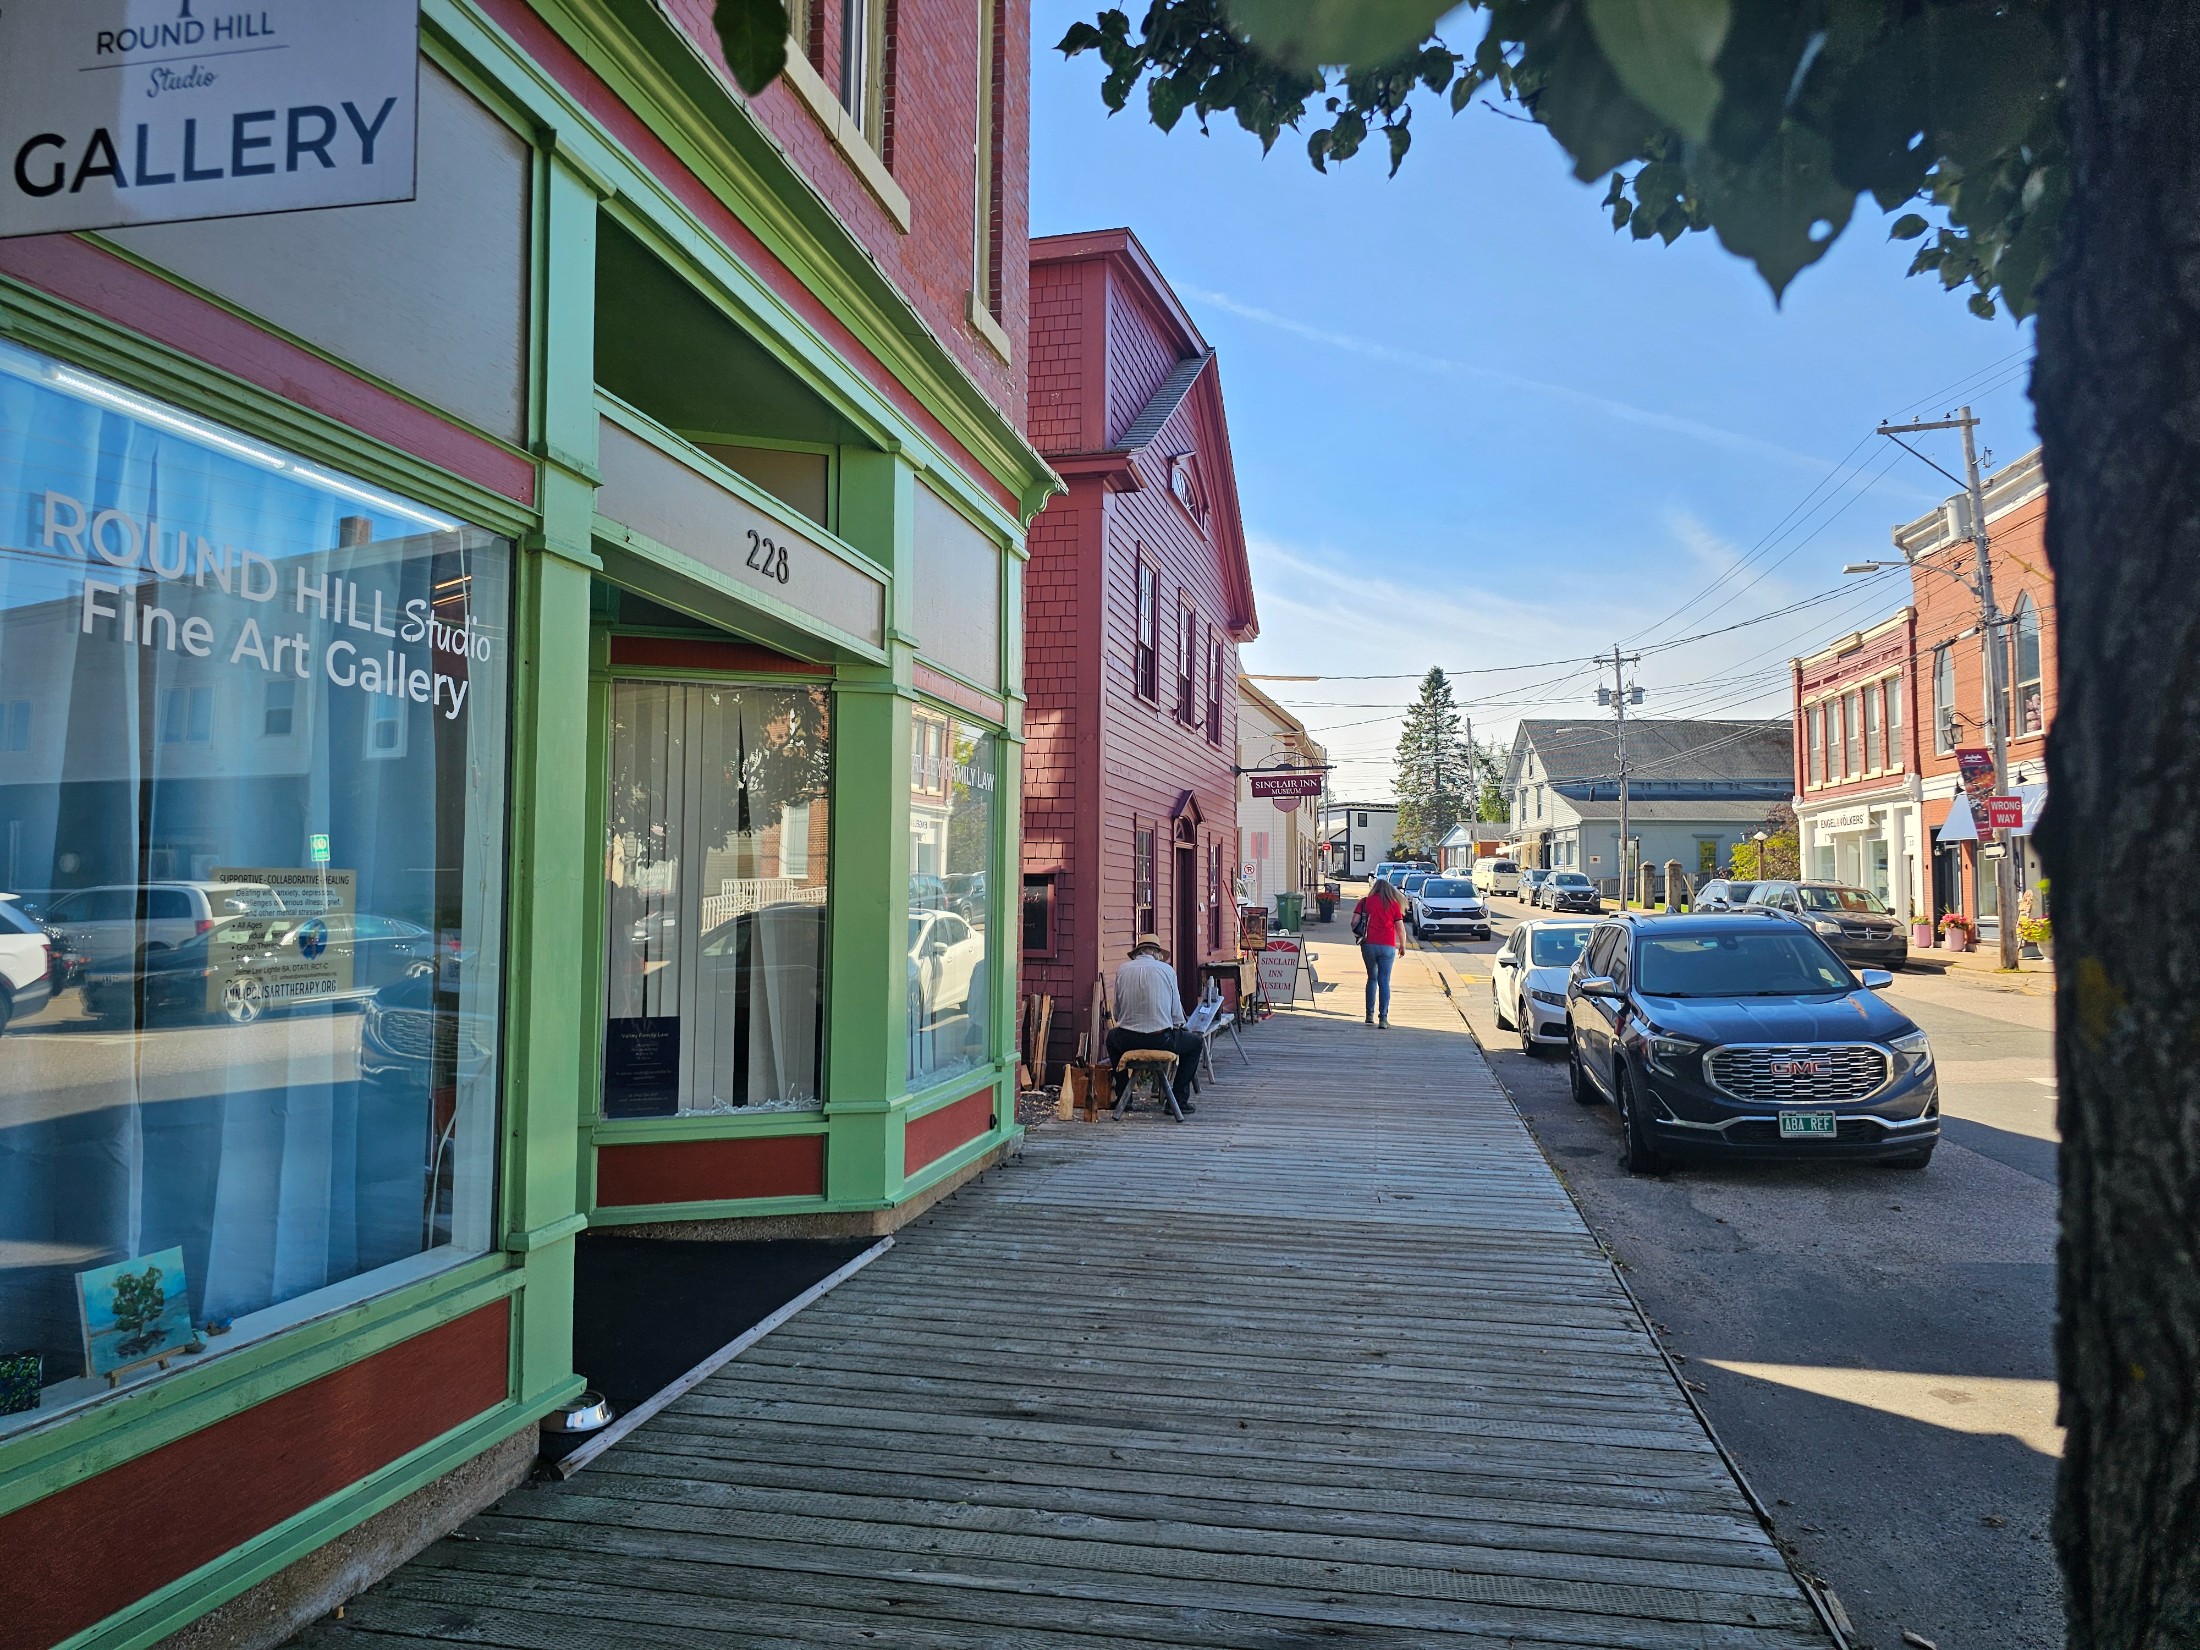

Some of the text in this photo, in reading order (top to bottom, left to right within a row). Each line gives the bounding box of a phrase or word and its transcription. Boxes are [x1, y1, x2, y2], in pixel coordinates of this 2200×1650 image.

[96, 11, 276, 55] ROUND HILL
[146, 64, 219, 98] Studio
[14, 96, 399, 198] GALLERY
[746, 529, 790, 585] 228
[43, 489, 492, 663] ROUND HILL Studio
[82, 578, 470, 721] Fine Art Gallery
[911, 753, 995, 792] ALLEY FAMILY LAW
[1255, 778, 1318, 789] SINCLAIR INN
[1990, 801, 2021, 811] WRONG
[1996, 813, 2016, 824] WAY
[219, 874, 263, 884] SUPPORTIVE
[267, 875, 319, 885] COLLABORATIVE
[236, 889, 261, 898] Dealing
[301, 889, 335, 898] depresson,
[239, 899, 273, 909] hallenges
[247, 921, 263, 931] Ages
[236, 943, 256, 951] Group
[1261, 957, 1296, 966] SINCLAIR
[1268, 969, 1283, 978] INN
[1771, 1060, 1832, 1075] GMC
[1810, 1117, 1830, 1131] REF
